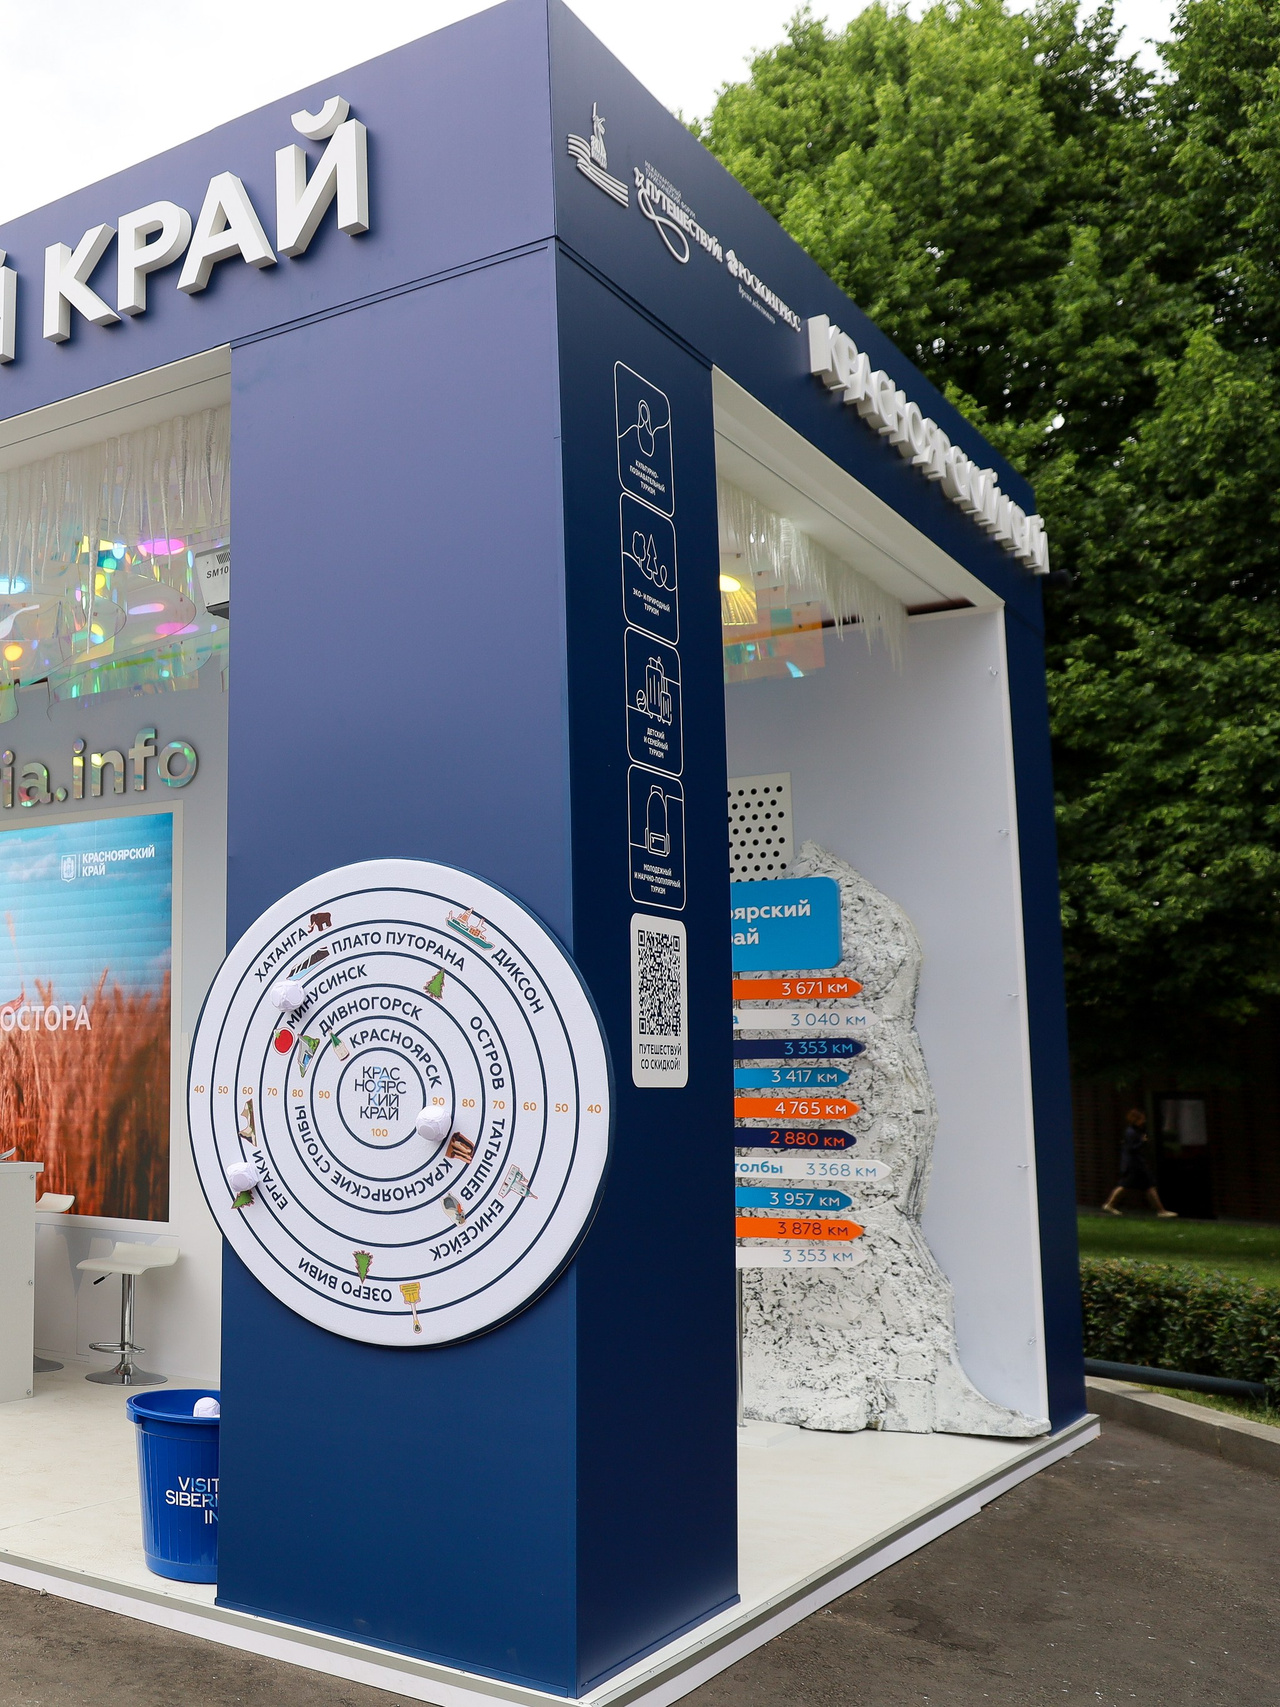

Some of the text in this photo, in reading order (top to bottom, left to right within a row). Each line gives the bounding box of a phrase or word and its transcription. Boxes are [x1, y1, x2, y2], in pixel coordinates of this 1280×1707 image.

[42, 95, 370, 345] КРАЙ
[82, 844, 155, 864] КРАСНОЯРСКИЙ
[82, 862, 106, 877] КРАЙ
[731, 927, 759, 945] ай
[254, 927, 308, 982] ХАТАНГА
[331, 931, 466, 971] ПЛАТО ПУТОРАНА
[491, 948, 544, 1014] ДИКСОН
[781, 982, 791, 996] 3
[796, 981, 824, 995] 671
[286, 964, 368, 1030] МИНУСИНСК
[318, 996, 423, 1037] ДИВНОГОРСК
[639, 1043, 682, 1056] ПУТЕШЕСТВУЙ
[784, 1041, 793, 1055] 3
[798, 1041, 827, 1054] 353
[349, 1028, 442, 1089] КРАСНОЯРСК
[640, 1057, 681, 1071] СО СКИДКОЙ!
[363, 1066, 400, 1080] КРАС
[771, 1070, 781, 1083] 3
[785, 1070, 812, 1082] 417
[194, 1085, 330, 1099] 40 50 60 70 80 90
[354, 1079, 407, 1094] НОЯРС
[368, 1093, 400, 1107] КИЙ
[432, 1097, 602, 1113] 90 80 70 60 50 40
[775, 1102, 785, 1115] 4
[789, 1101, 820, 1115] 765
[360, 1106, 399, 1121] КРАЙ
[460, 1016, 505, 1201] ОСТРОВ ТАТЫШЕВ
[371, 1128, 388, 1137] 100
[770, 1130, 780, 1144] 2
[784, 1131, 819, 1146] 880
[294, 1105, 453, 1202] КРАСНОЯРСКИЕ СТОЛБЫ
[818, 1163, 851, 1176] 368
[252, 1150, 288, 1210] ЕРГАКИ
[770, 1192, 779, 1205] 3
[784, 1192, 815, 1206] 957
[429, 1198, 505, 1261] ЕНИСЕЙСК
[778, 1221, 787, 1234] 3
[792, 1222, 822, 1235] 878
[782, 1249, 792, 1262] 3
[797, 1249, 827, 1262] 353
[298, 1257, 338, 1289] ВИВИ
[341, 1282, 393, 1302] ОЗЕРО
[177, 1475, 220, 1493] VISIT
